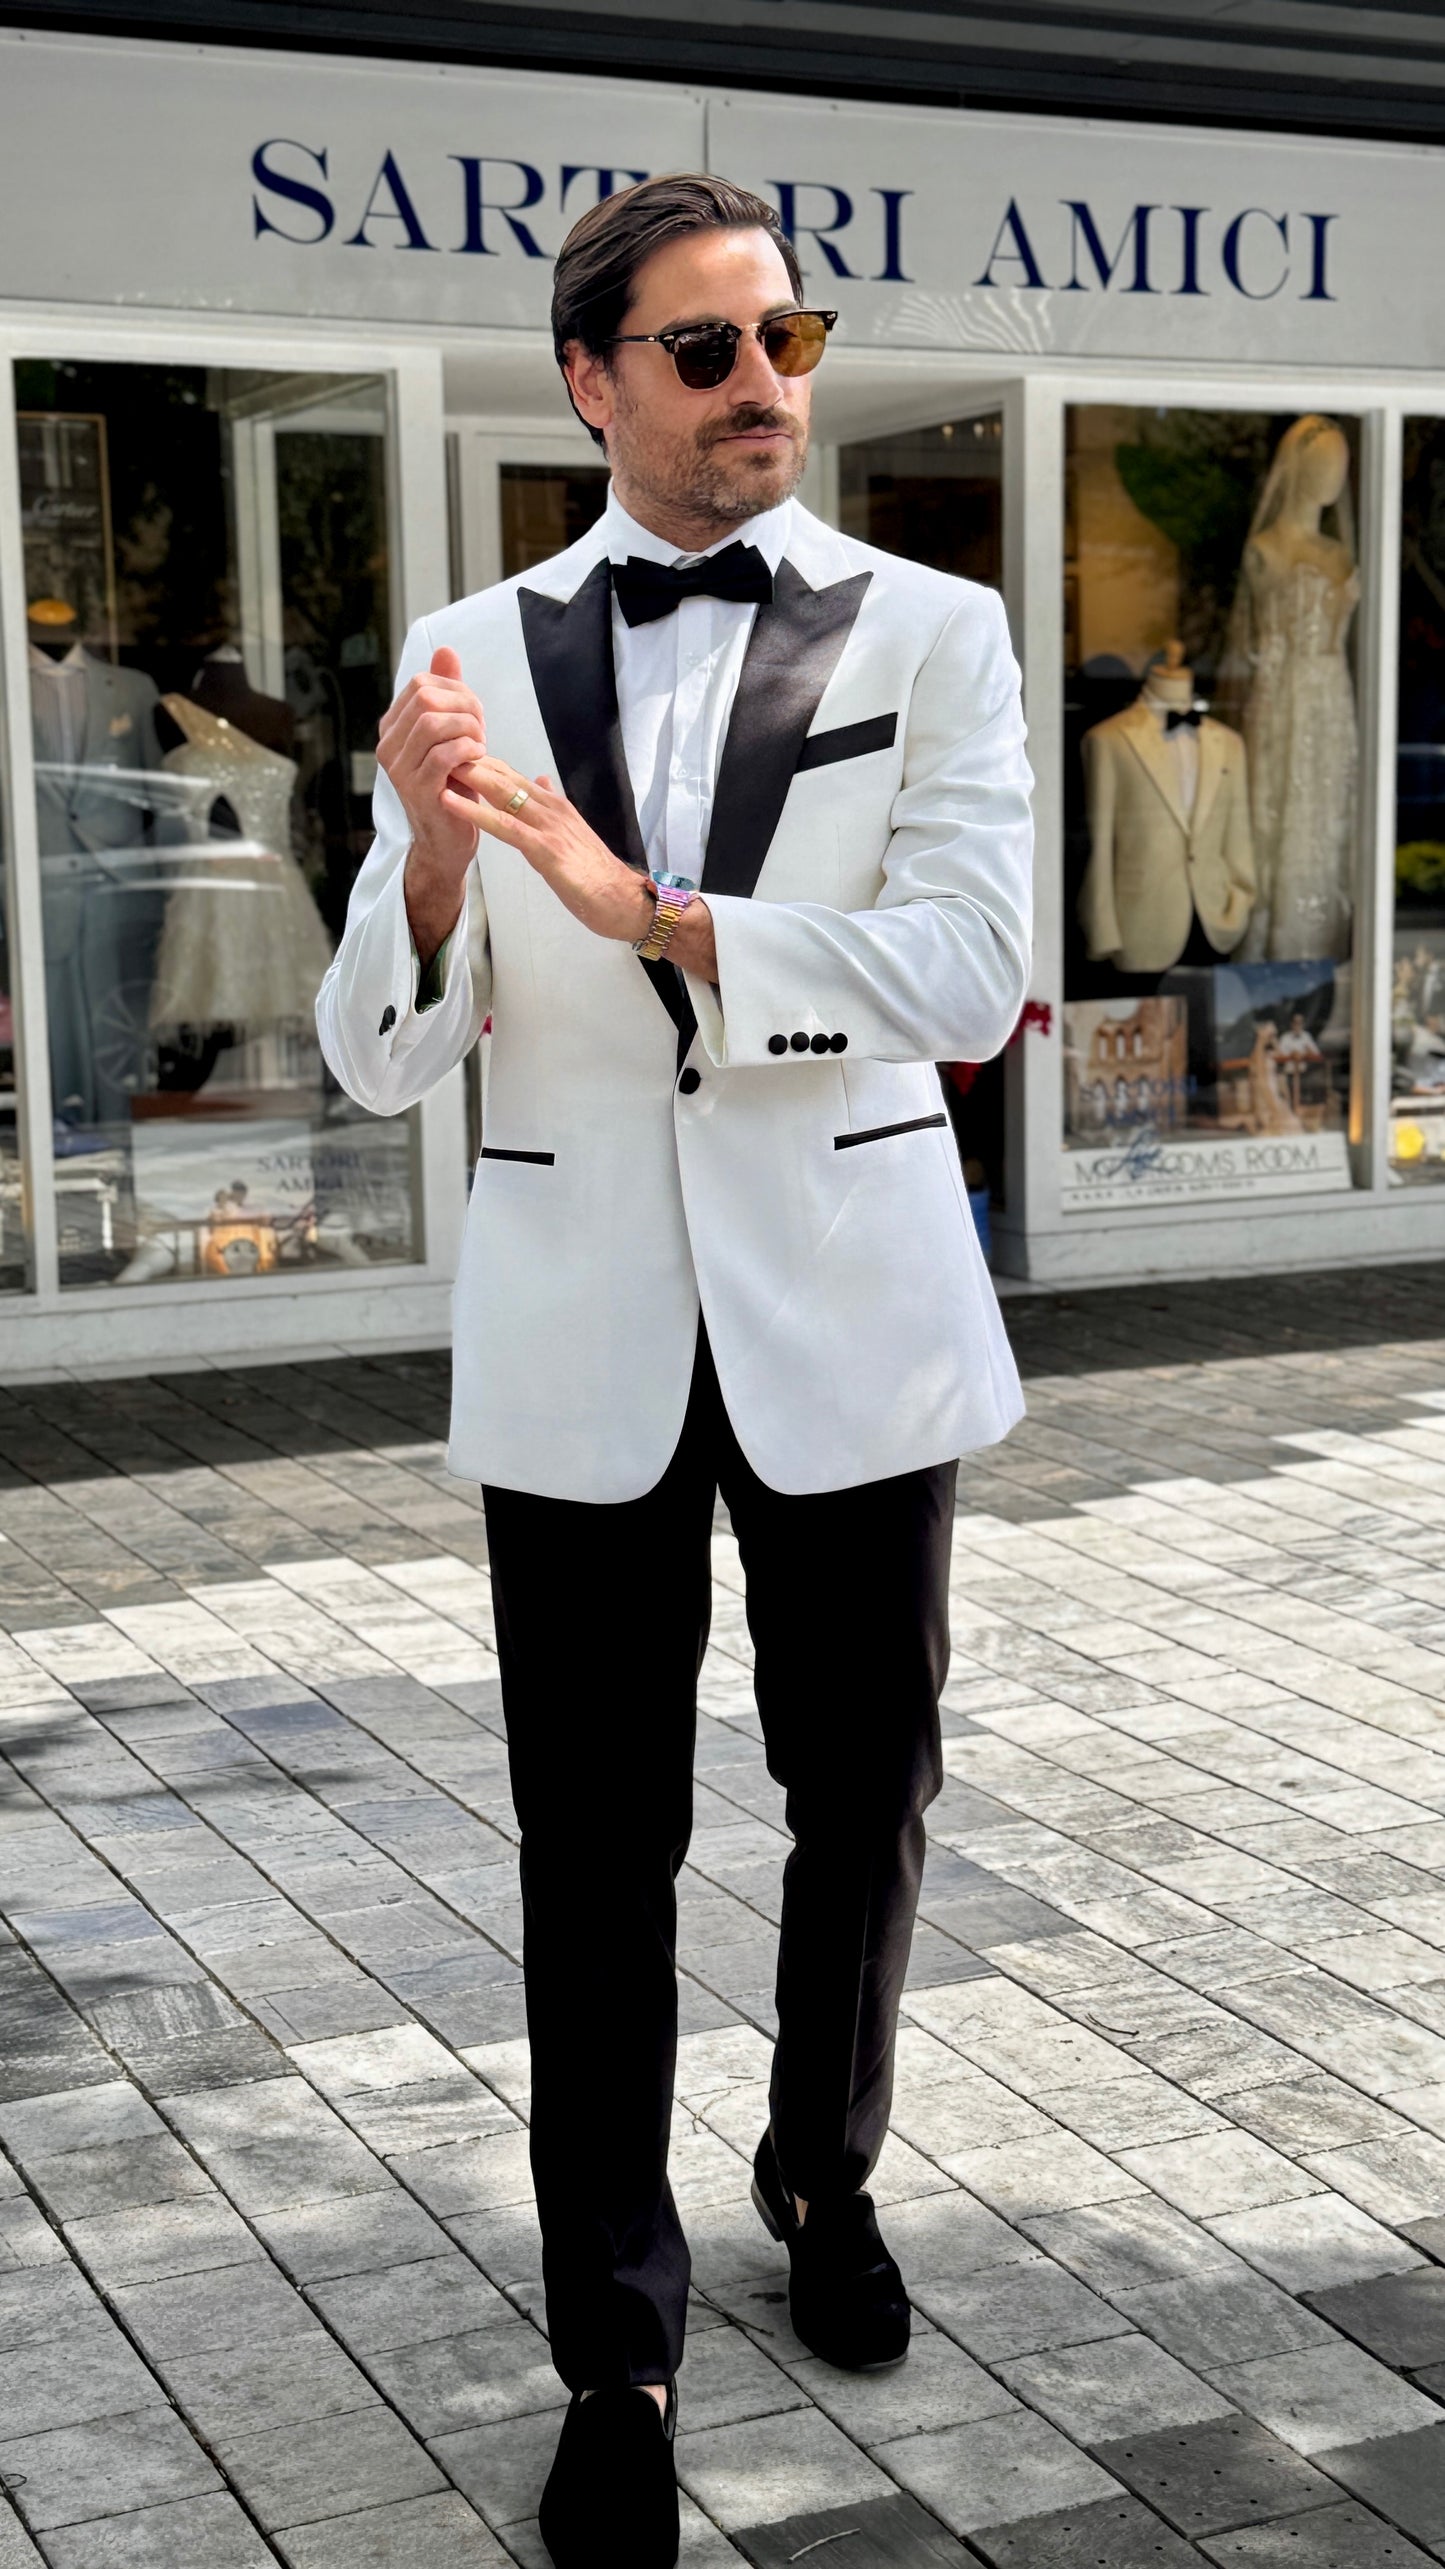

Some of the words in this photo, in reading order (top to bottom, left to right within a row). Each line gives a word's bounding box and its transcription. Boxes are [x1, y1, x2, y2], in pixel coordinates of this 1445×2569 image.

[250, 138, 914, 284] SARTRI
[973, 197, 1340, 302] AMICI
[1245, 1143, 1320, 1171] ROOM
